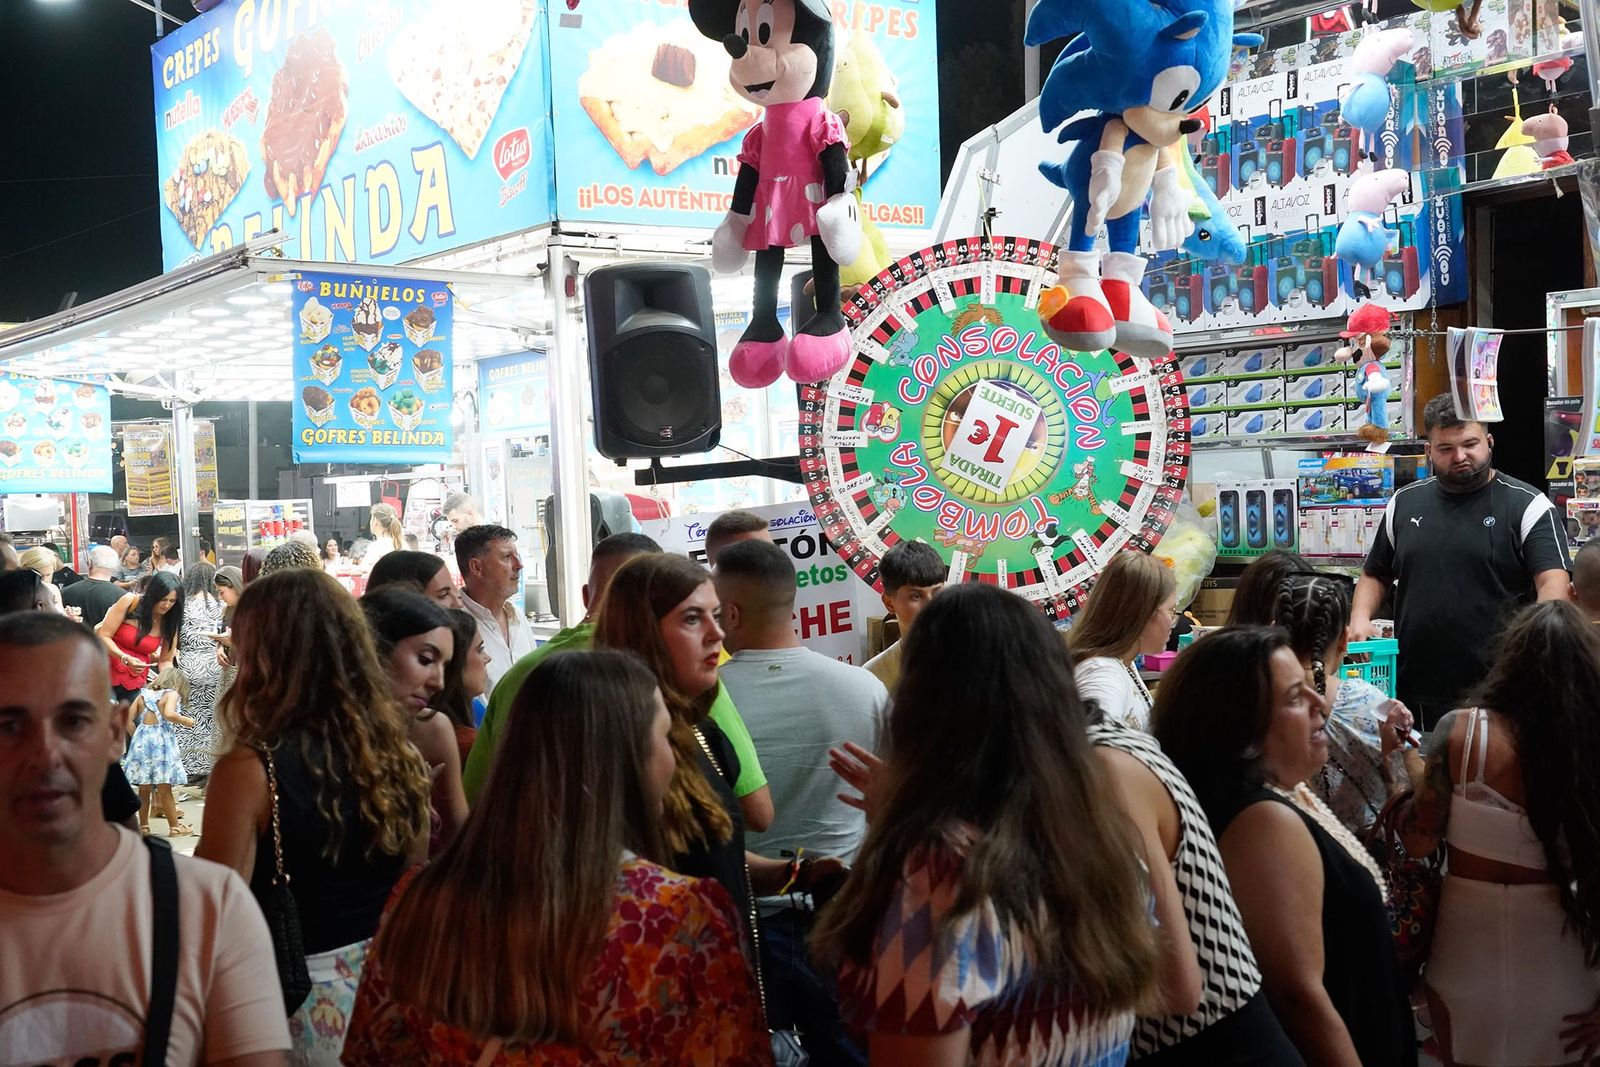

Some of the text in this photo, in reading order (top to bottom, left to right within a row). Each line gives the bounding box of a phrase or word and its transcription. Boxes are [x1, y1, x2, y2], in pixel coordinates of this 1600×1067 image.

[162, 26, 221, 90] CREPES
[1303, 63, 1343, 83] ALTAVOZ
[1237, 80, 1276, 98] ALTAVOZ
[164, 89, 202, 131] nutella
[499, 136, 528, 168] Lotus
[638, 186, 734, 212] AUTÉNTIC
[861, 204, 924, 224] LGAS!!
[1270, 193, 1310, 211] ALTAVOZ
[1435, 195, 1447, 245] ROCK
[1028, 246, 1037, 254] 49
[1039, 249, 1048, 257] 50
[847, 305, 857, 315] 32
[855, 297, 865, 307] 33
[864, 289, 873, 298] 34
[872, 281, 882, 291] 35
[882, 274, 892, 284] 36
[892, 268, 901, 277] 37
[902, 262, 912, 271] 38
[912, 257, 922, 266] 39
[924, 253, 933, 261] 40
[932, 250, 944, 258] 41
[946, 246, 956, 254] 42
[981, 240, 991, 249] 45
[319, 280, 426, 303] BUÑUELOS
[1165, 363, 1173, 372] 65
[1168, 374, 1176, 383] 66
[901, 326, 1107, 450] CONSOLACION
[1172, 385, 1180, 394] 67
[807, 389, 815, 399] 24
[805, 401, 813, 410] 23
[979, 386, 1035, 420] SUERTE
[1174, 397, 1182, 406] 68
[1176, 408, 1183, 417] 69
[804, 413, 812, 422] 22
[1177, 420, 1184, 429] 70
[804, 425, 811, 434] 21
[301, 429, 445, 446] GOFRES BELINDA
[804, 436, 811, 445] 20
[1177, 432, 1184, 440] 71
[804, 448, 812, 456] 19
[1175, 443, 1184, 452] 72
[806, 459, 814, 468] 18
[1173, 455, 1183, 464] 73
[948, 452, 1003, 489] TIRADA
[1173, 467, 1181, 475] 74
[808, 472, 816, 480] 17
[811, 482, 820, 492] 16
[1168, 478, 1178, 487] 75
[889, 441, 1061, 541] TOMBOLA
[1166, 489, 1175, 498] 76
[815, 493, 823, 503] 15
[820, 504, 828, 514] 14
[1162, 500, 1171, 509] 77
[825, 515, 833, 524] 13
[1155, 510, 1166, 520] 78
[830, 525, 839, 534] 12
[1152, 521, 1160, 530] 79
[837, 535, 846, 544] 11
[844, 544, 853, 553] 10
[796, 562, 848, 588] etos
[1045, 530, 1155, 615] 80 81 88 89 90 91
